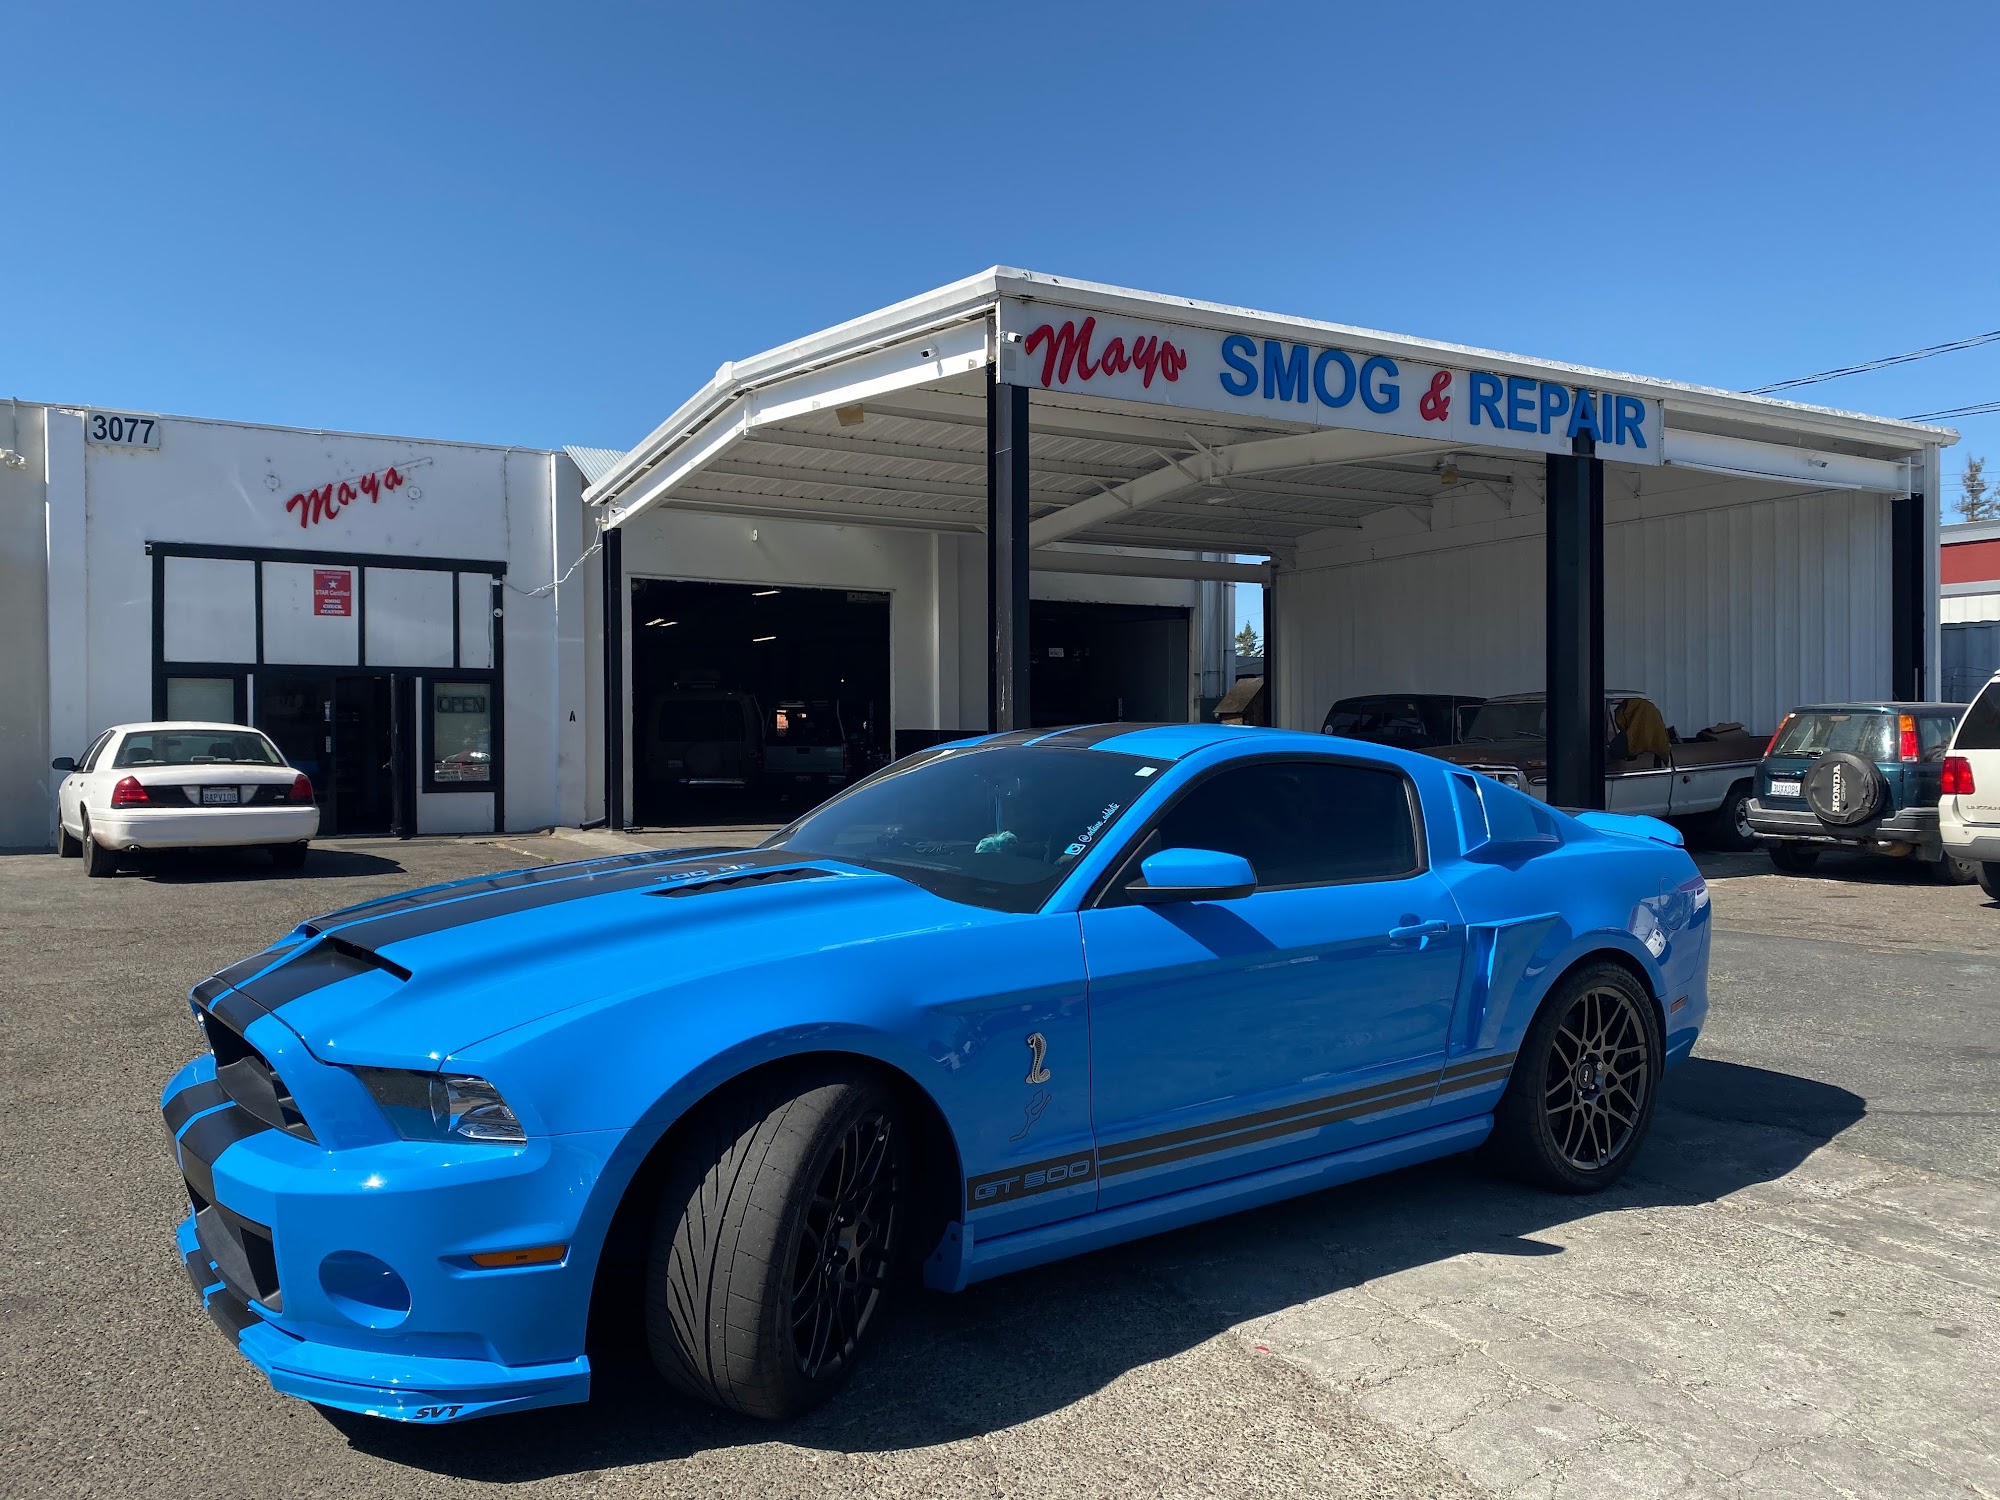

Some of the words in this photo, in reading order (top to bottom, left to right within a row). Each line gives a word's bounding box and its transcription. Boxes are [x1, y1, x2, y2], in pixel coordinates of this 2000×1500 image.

[1219, 334, 1400, 414] SMOG
[1419, 370, 1452, 422] &
[1469, 371, 1648, 449] REPAIR
[92, 414, 155, 444] 3077
[286, 467, 403, 529] Maya
[439, 696, 483, 713] OPEN
[1832, 764, 1841, 812] HONDA
[653, 869, 710, 882] 700
[717, 862, 756, 873] HP
[974, 1176, 1019, 1200] GT
[1023, 1160, 1090, 1189] 500
[412, 1405, 464, 1419] SVT
